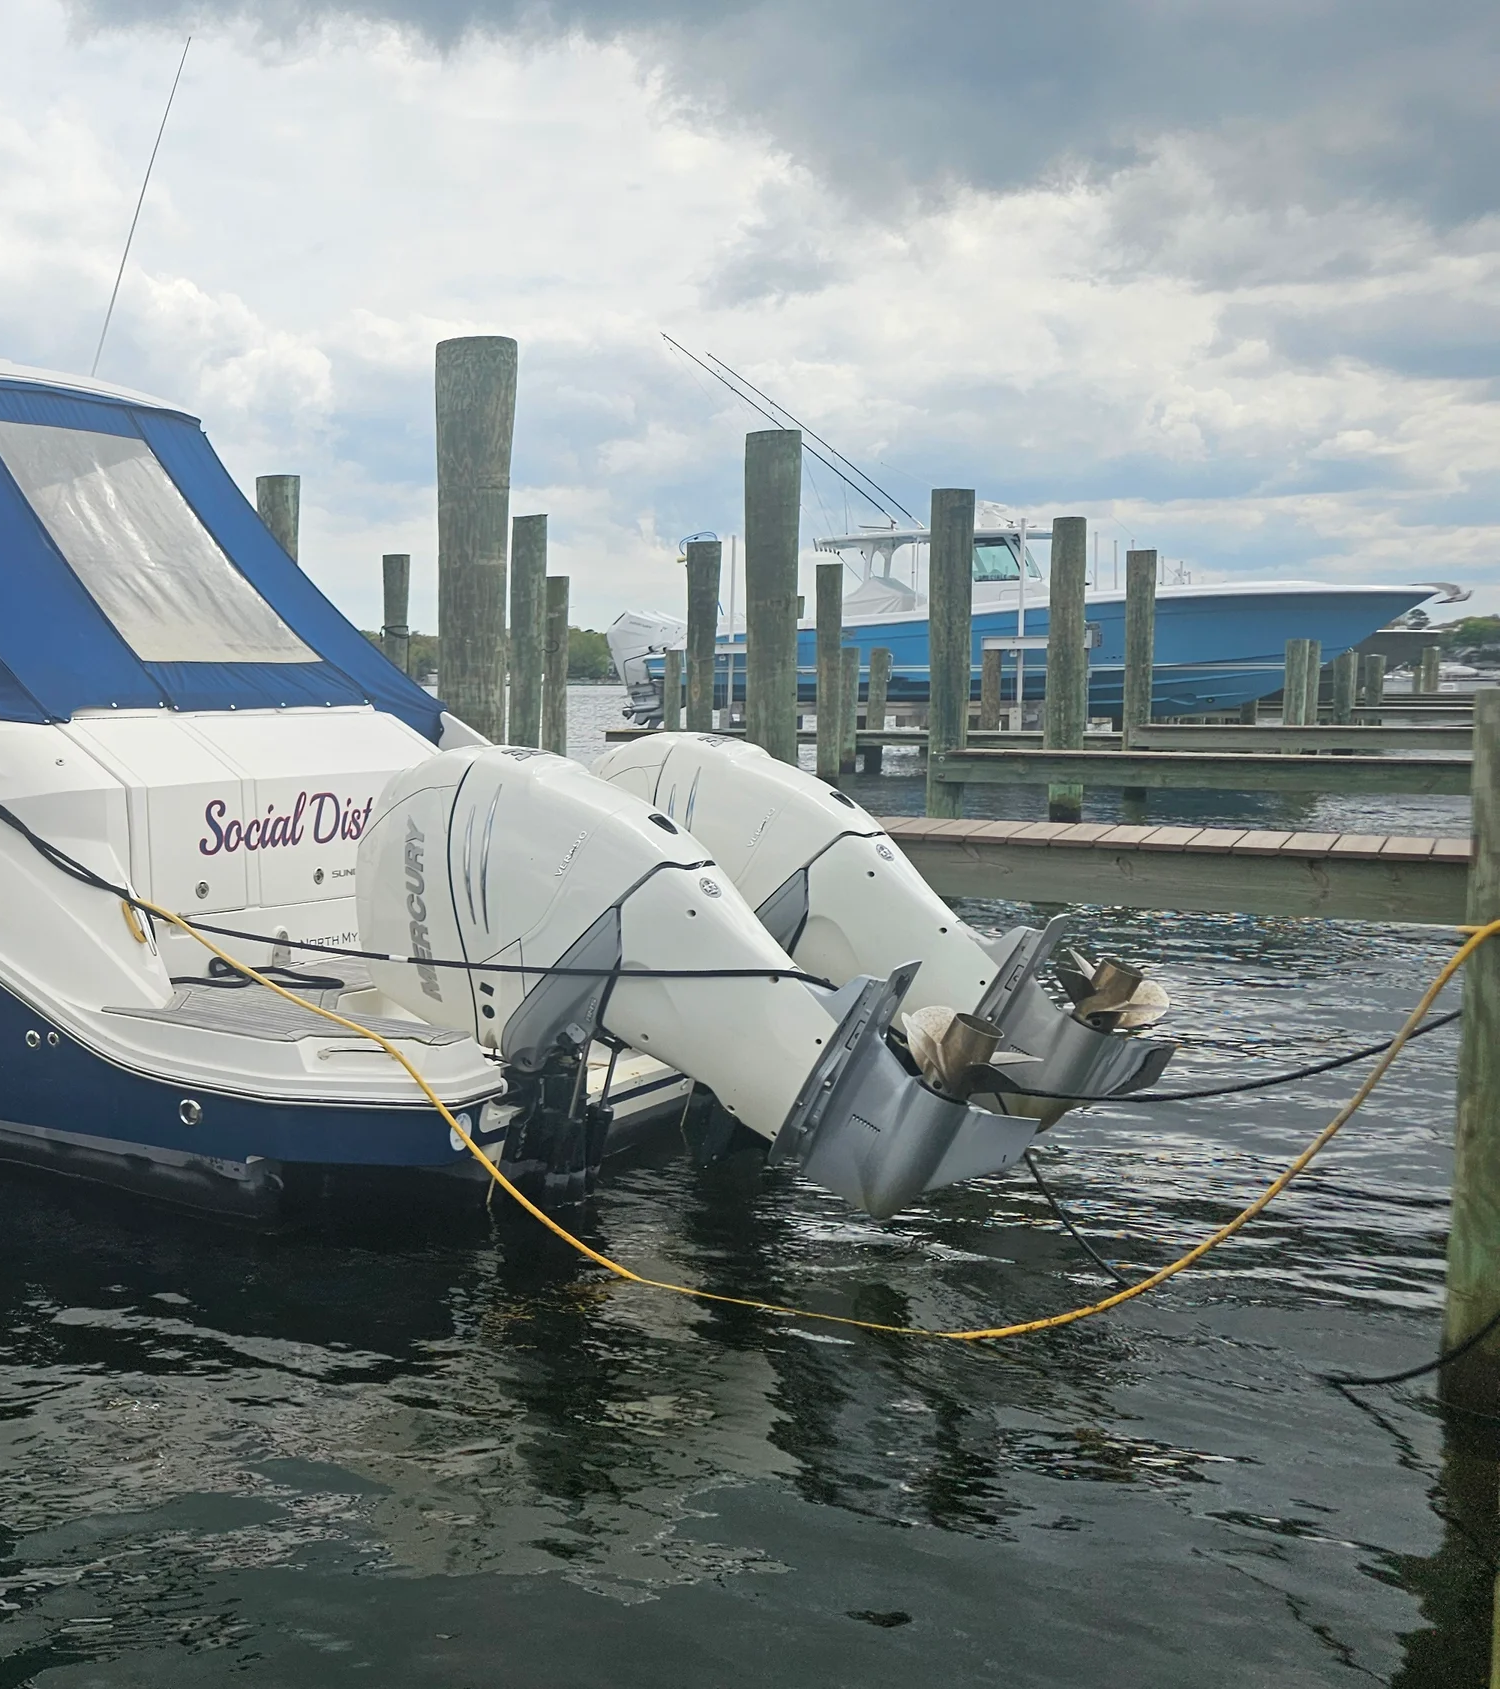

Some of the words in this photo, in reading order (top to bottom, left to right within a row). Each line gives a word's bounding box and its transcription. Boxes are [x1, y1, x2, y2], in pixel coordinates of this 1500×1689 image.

[199, 791, 307, 855] Social
[309, 792, 373, 844] Dist
[554, 830, 588, 877] VERADO
[405, 814, 443, 1003] MERCURY
[342, 931, 361, 944] MY
